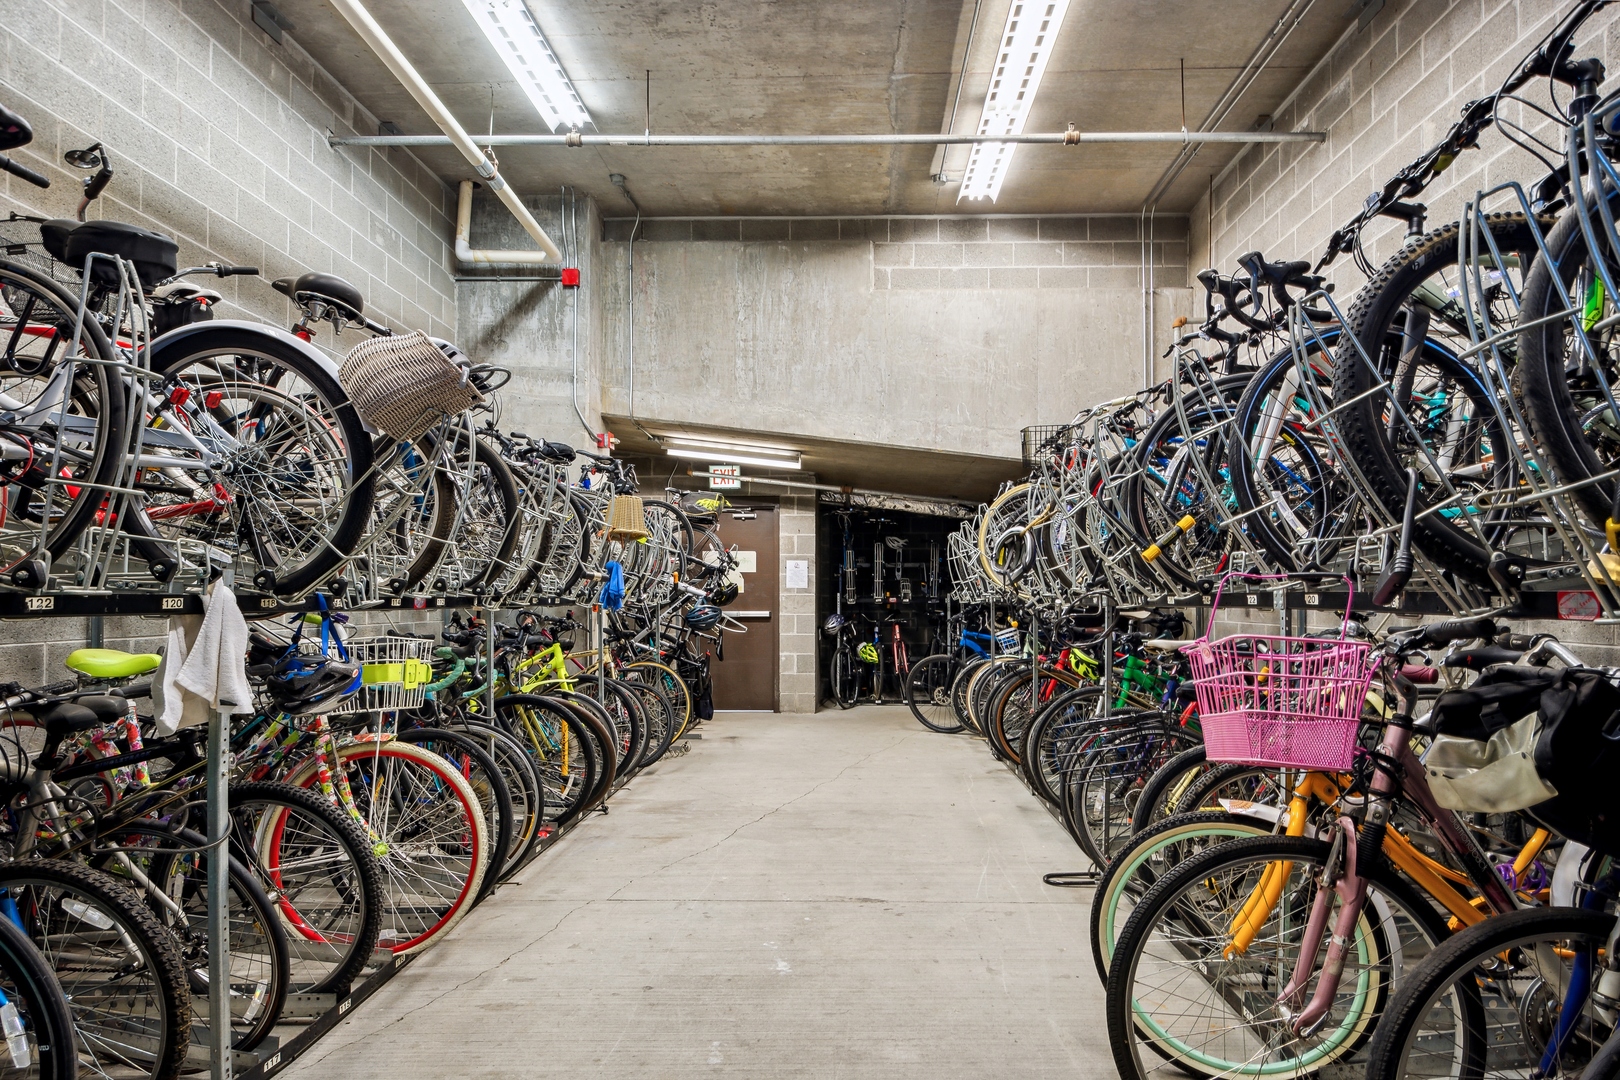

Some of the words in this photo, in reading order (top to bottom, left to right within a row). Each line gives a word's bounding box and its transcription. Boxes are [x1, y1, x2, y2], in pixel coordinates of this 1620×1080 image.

[713, 469, 737, 485] EXIT
[28, 598, 52, 608] 122
[164, 598, 183, 608] 120
[1249, 596, 1256, 604] 22
[1307, 595, 1316, 604] 20
[340, 999, 351, 1012] 115
[265, 1054, 280, 1070] 117
